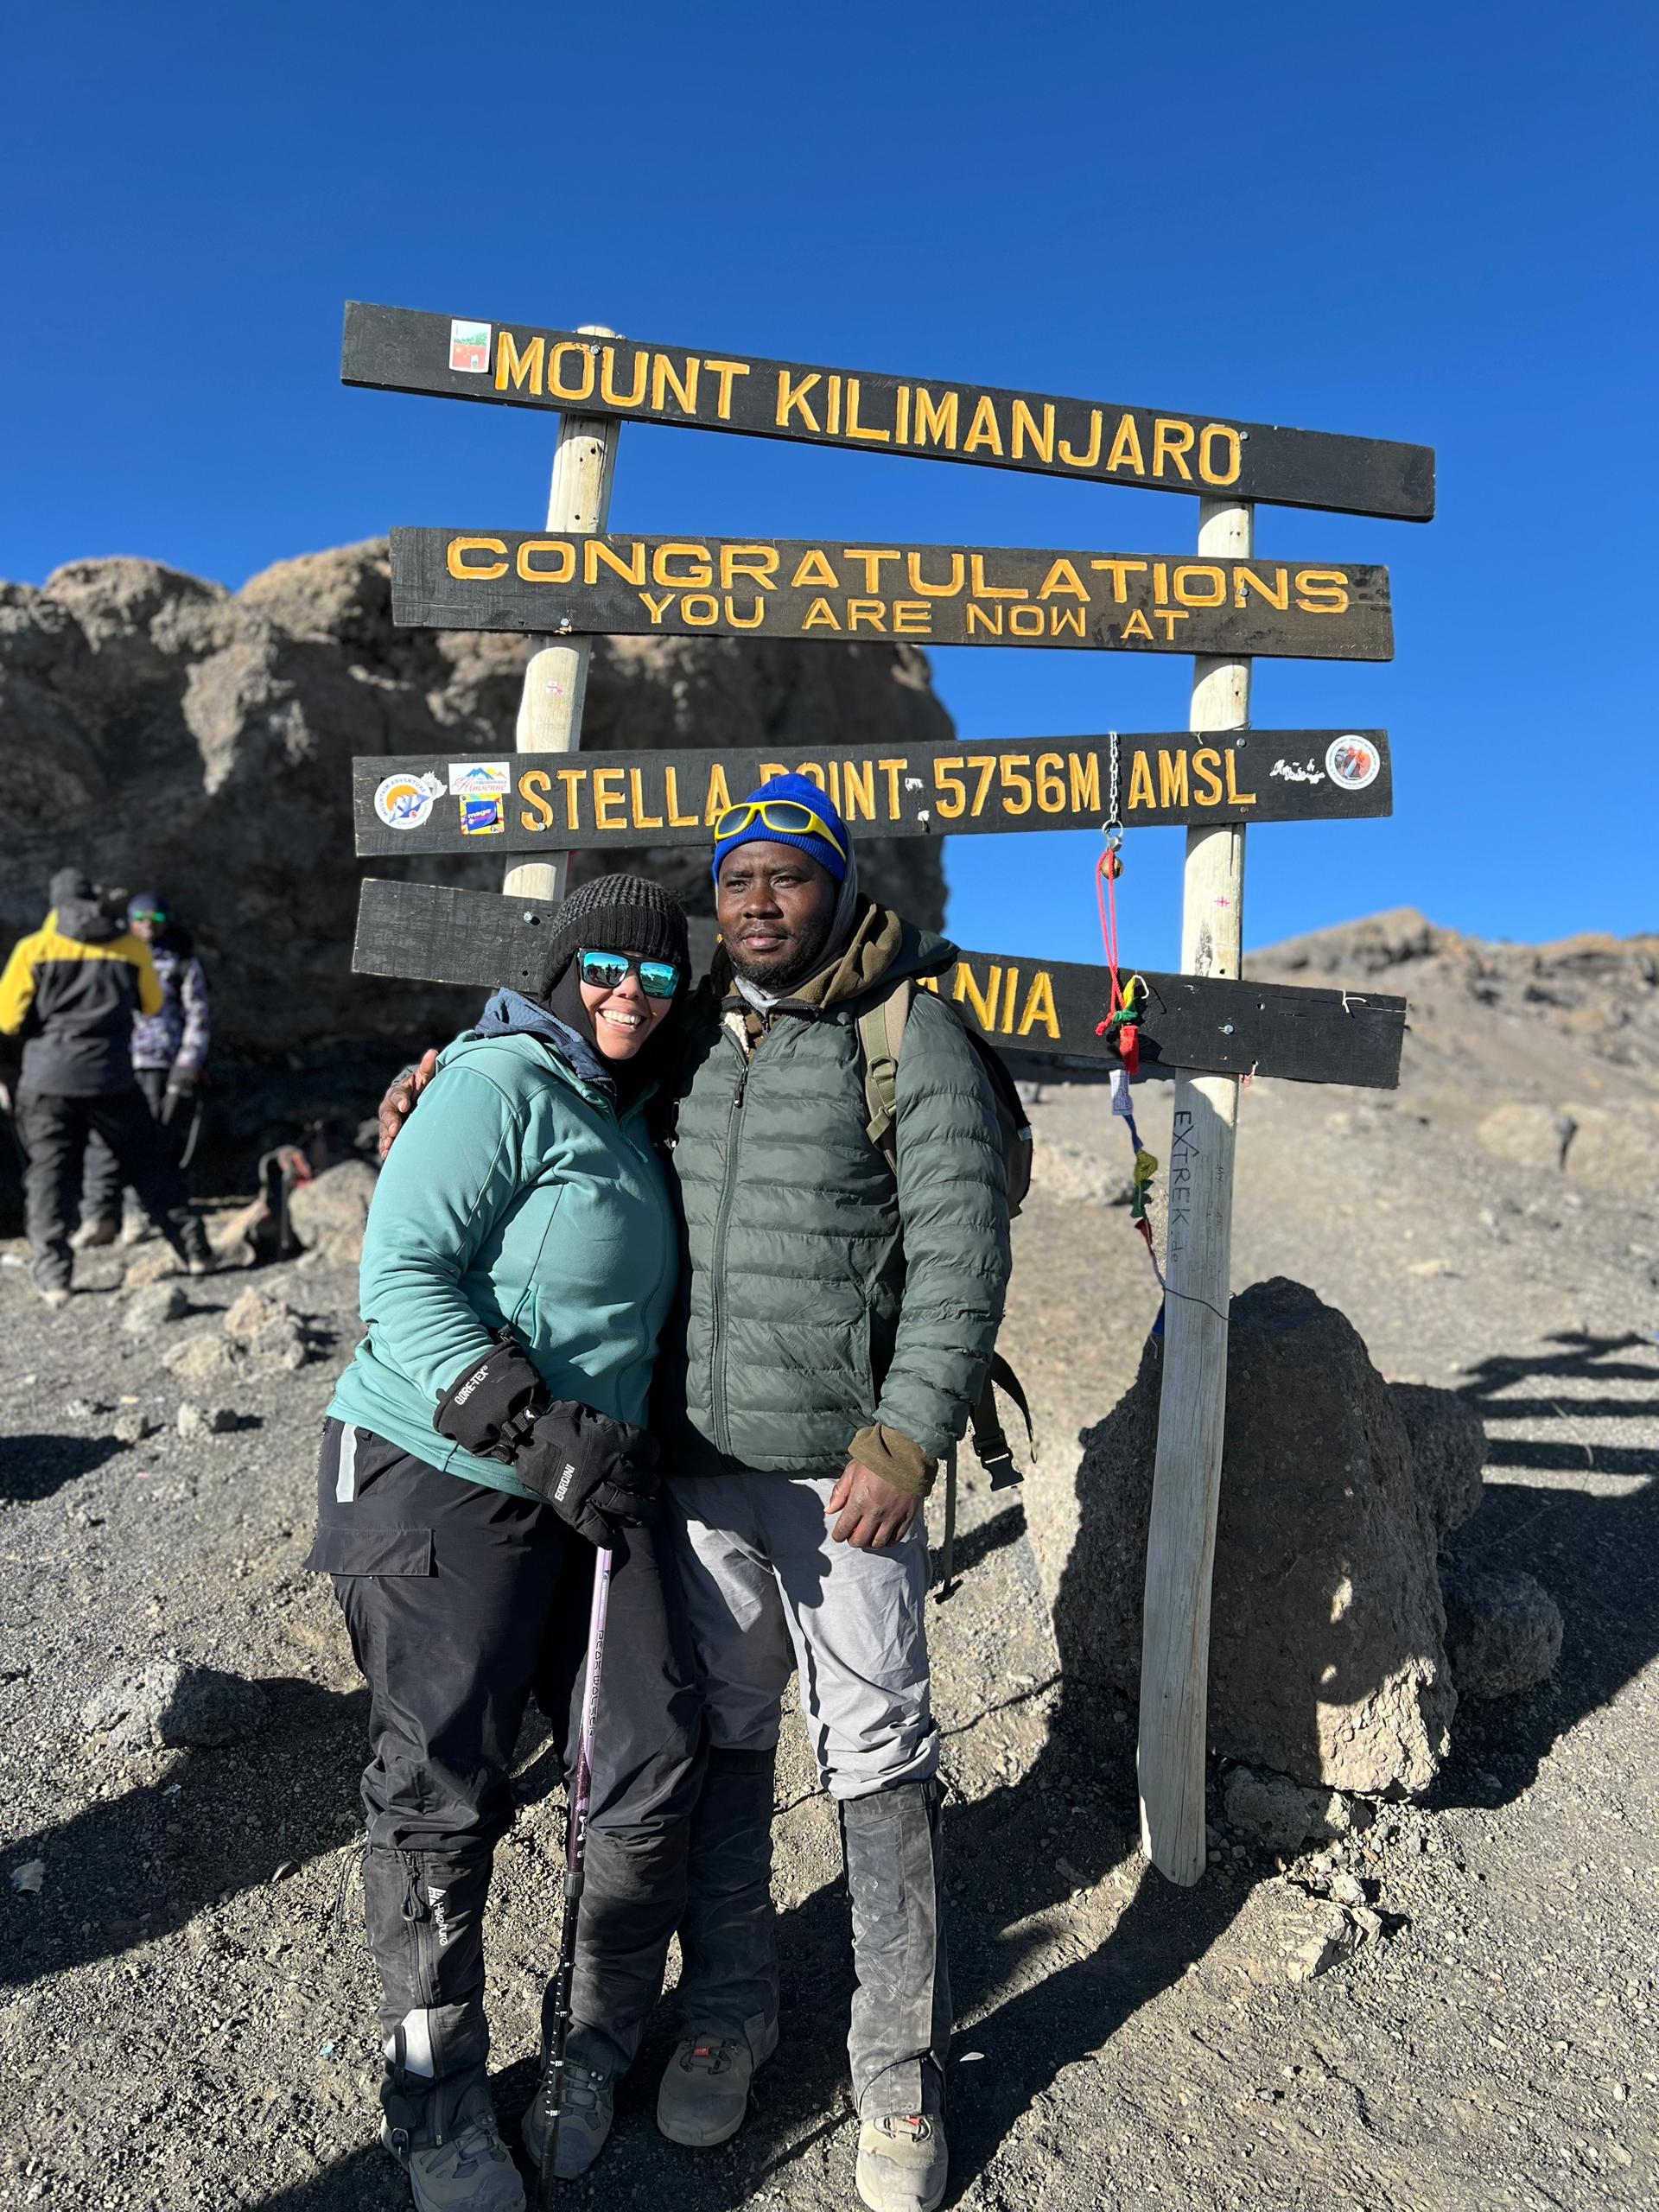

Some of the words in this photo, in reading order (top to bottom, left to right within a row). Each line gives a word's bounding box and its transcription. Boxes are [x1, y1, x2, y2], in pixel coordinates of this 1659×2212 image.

[493, 330, 750, 420] MOUNT
[775, 370, 1243, 486] KILIMANJARO
[447, 537, 1350, 614] CONGRATULATIONS
[639, 592, 765, 629] YOU
[802, 597, 931, 633] ARE
[966, 602, 1086, 638] NOW
[1121, 607, 1189, 641] AT
[379, 784, 391, 817] MOUNTAIN
[391, 778, 426, 792] ADVENTURE
[518, 763, 731, 832] STELLA
[759, 759, 907, 821] INT
[934, 752, 1102, 819] 5756M
[1128, 748, 1256, 810] AMSL
[554, 1463, 575, 1503] GORDINI
[433, 1902, 448, 1946] Hiketure
